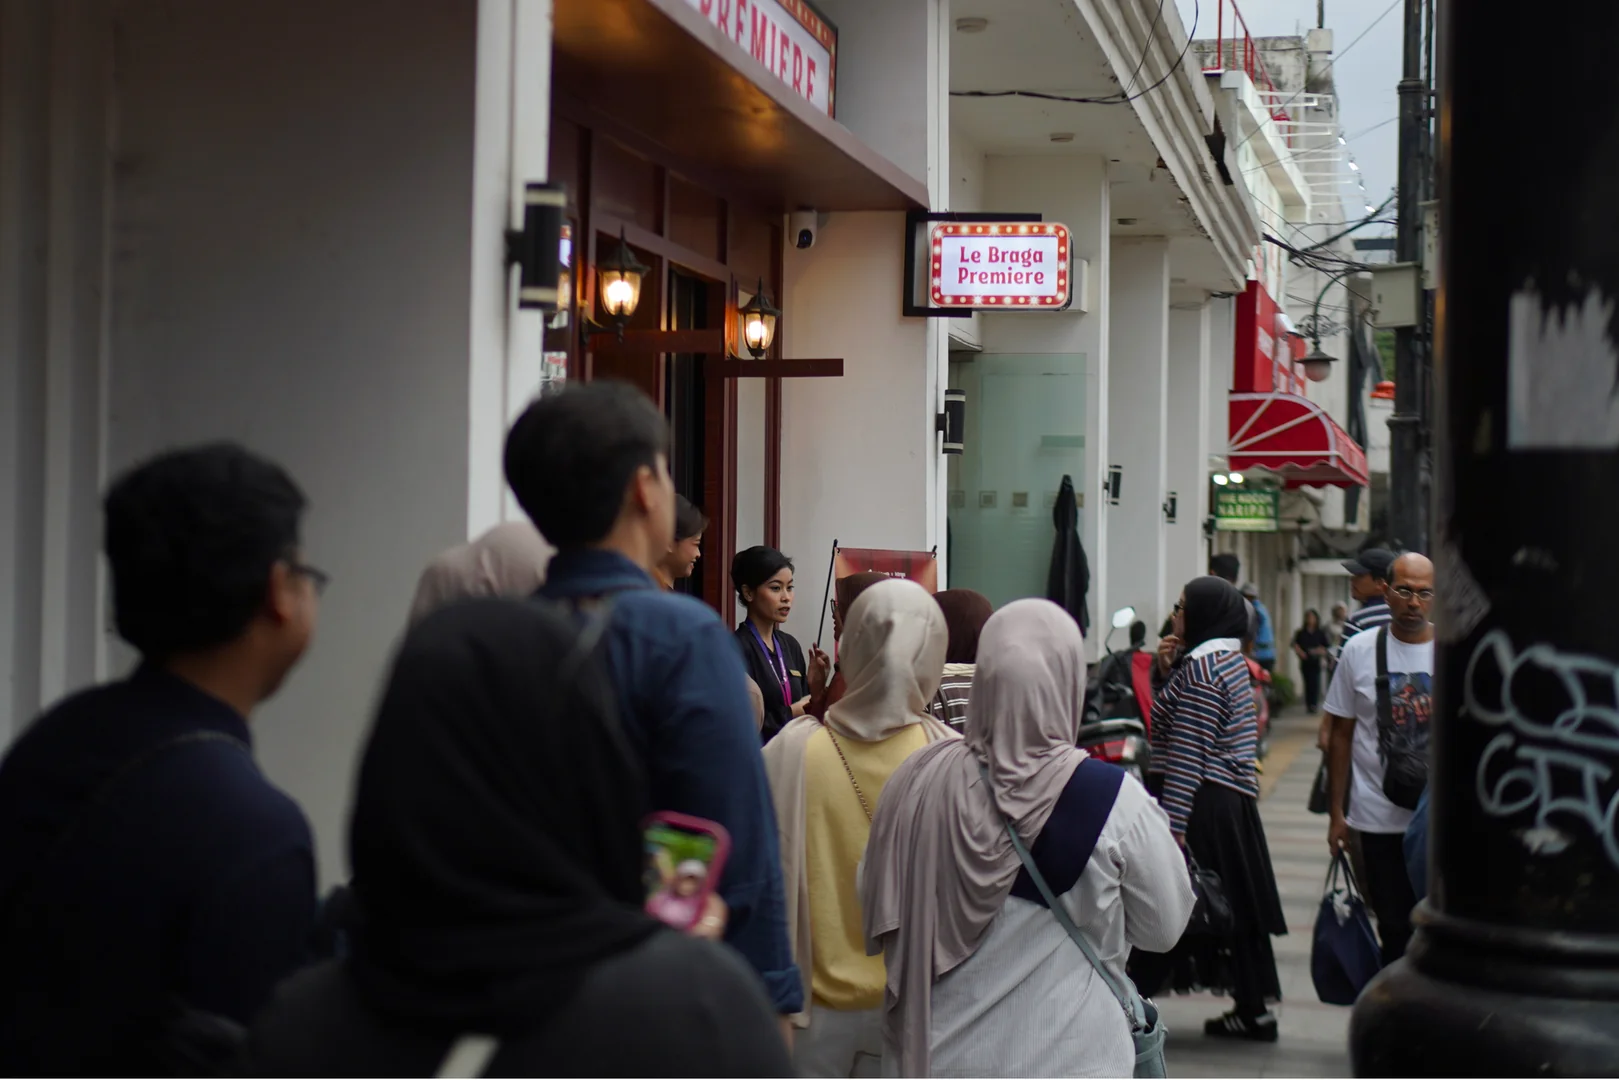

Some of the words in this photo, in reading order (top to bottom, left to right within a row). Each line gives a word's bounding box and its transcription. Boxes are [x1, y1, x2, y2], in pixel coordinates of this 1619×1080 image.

[699, 0, 817, 102] REMIERE
[960, 246, 981, 263] Le
[988, 246, 1043, 268] Braga
[958, 267, 1044, 284] Premiere
